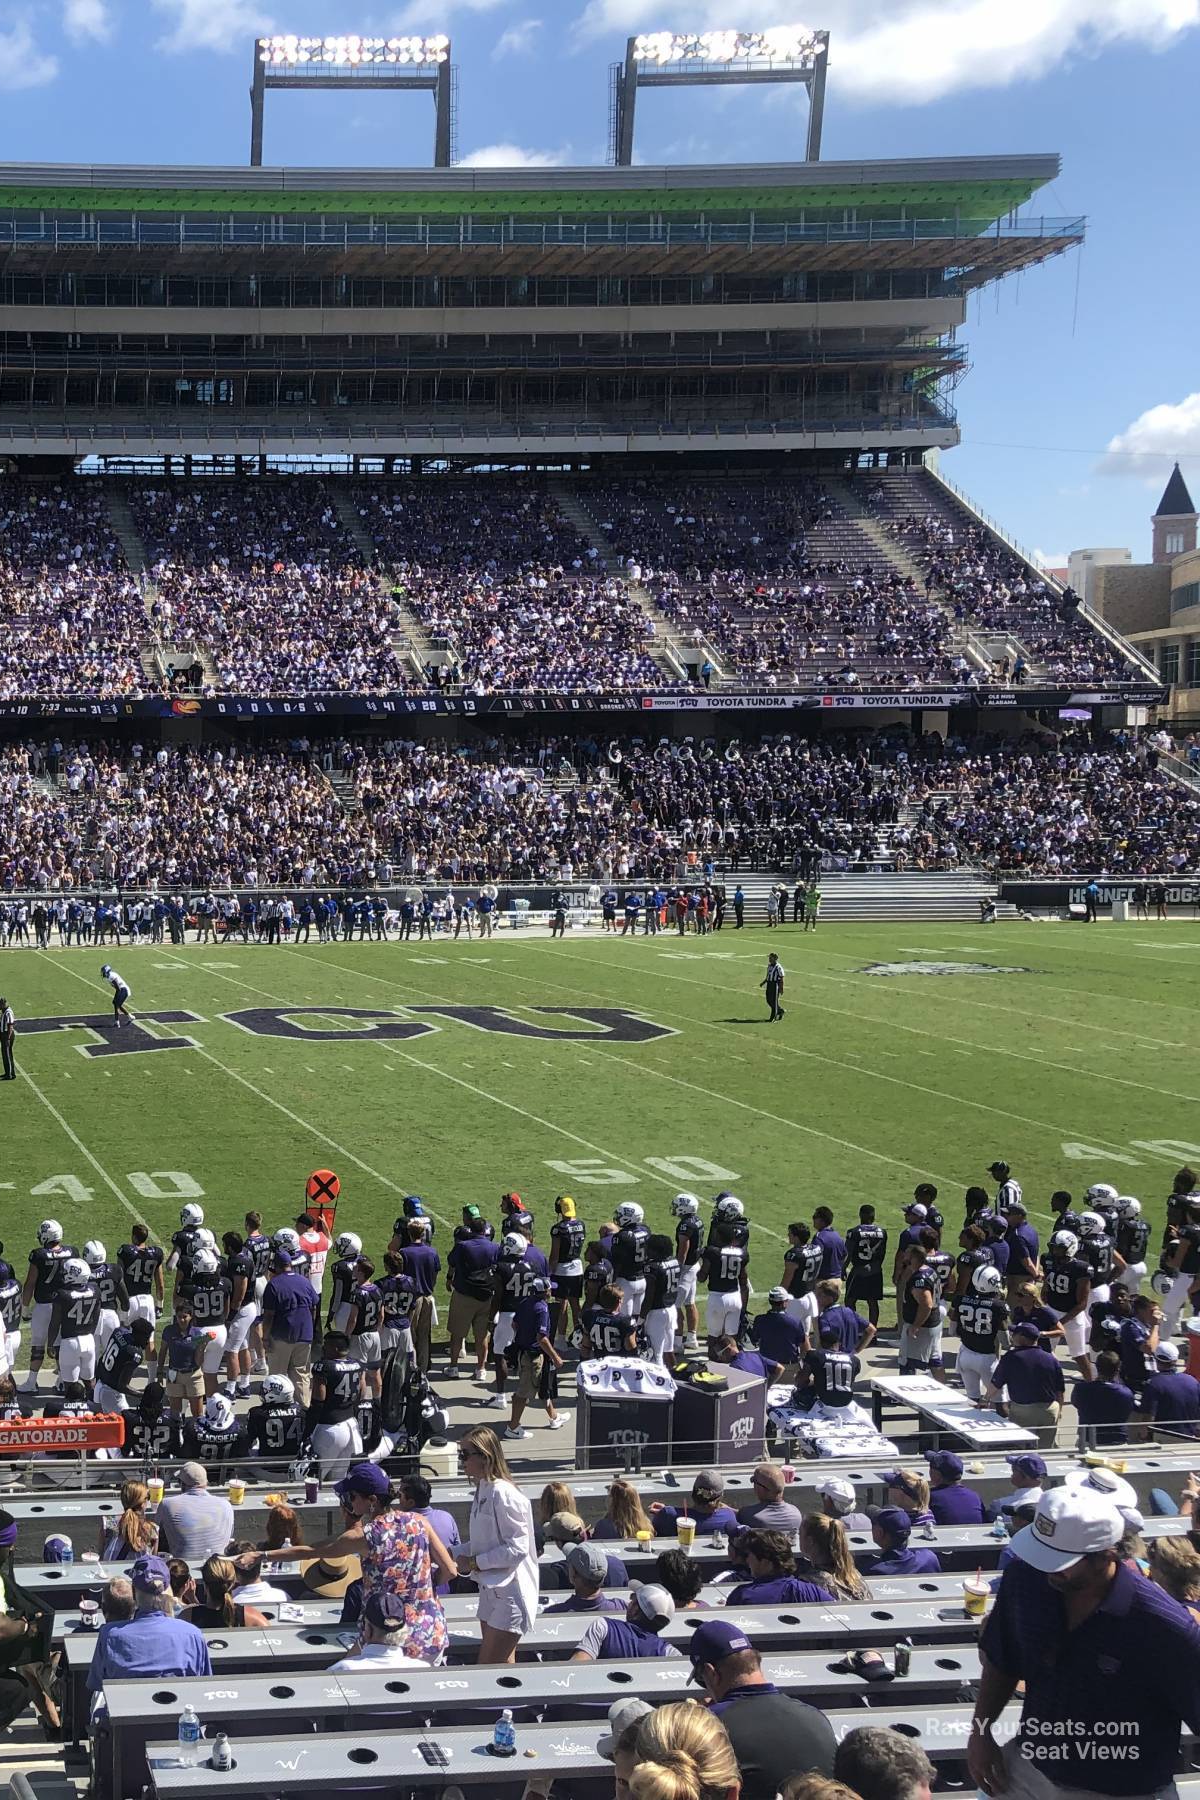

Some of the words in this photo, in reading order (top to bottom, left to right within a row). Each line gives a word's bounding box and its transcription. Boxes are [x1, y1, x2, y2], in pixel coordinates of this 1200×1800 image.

[17, 706, 28, 715] 10
[40, 703, 60, 712] 7:33
[90, 705, 102, 715] 31
[383, 701, 396, 711] 41
[422, 701, 437, 711] 28
[462, 700, 476, 711] 13
[678, 698, 699, 708] TCU
[707, 698, 745, 708] TOYOTA
[747, 697, 787, 708] TUNDRA
[835, 696, 855, 706] TCU
[862, 696, 901, 706] TOYOTA
[902, 696, 944, 706] TUNDRA
[14, 1003, 684, 1060] TCU
[542, 1155, 742, 1185] 50
[29, 1171, 206, 1202] 40
[720, 1254, 742, 1280] 19
[801, 1257, 823, 1282] 27
[506, 1271, 536, 1298] 42
[67, 1298, 97, 1326] 47
[193, 1290, 226, 1319] 99
[383, 1291, 414, 1316] 33
[958, 1304, 993, 1335] 28
[590, 1325, 622, 1353] 46
[822, 1362, 853, 1392] 10
[265, 1417, 303, 1449] 94
[729, 1415, 755, 1440] TCU
[960, 1418, 1008, 1431] TCU
[133, 1425, 172, 1454] 32
[608, 1428, 650, 1450] TCU
[203, 1690, 239, 1700] TCU
[434, 1679, 469, 1690] TCU
